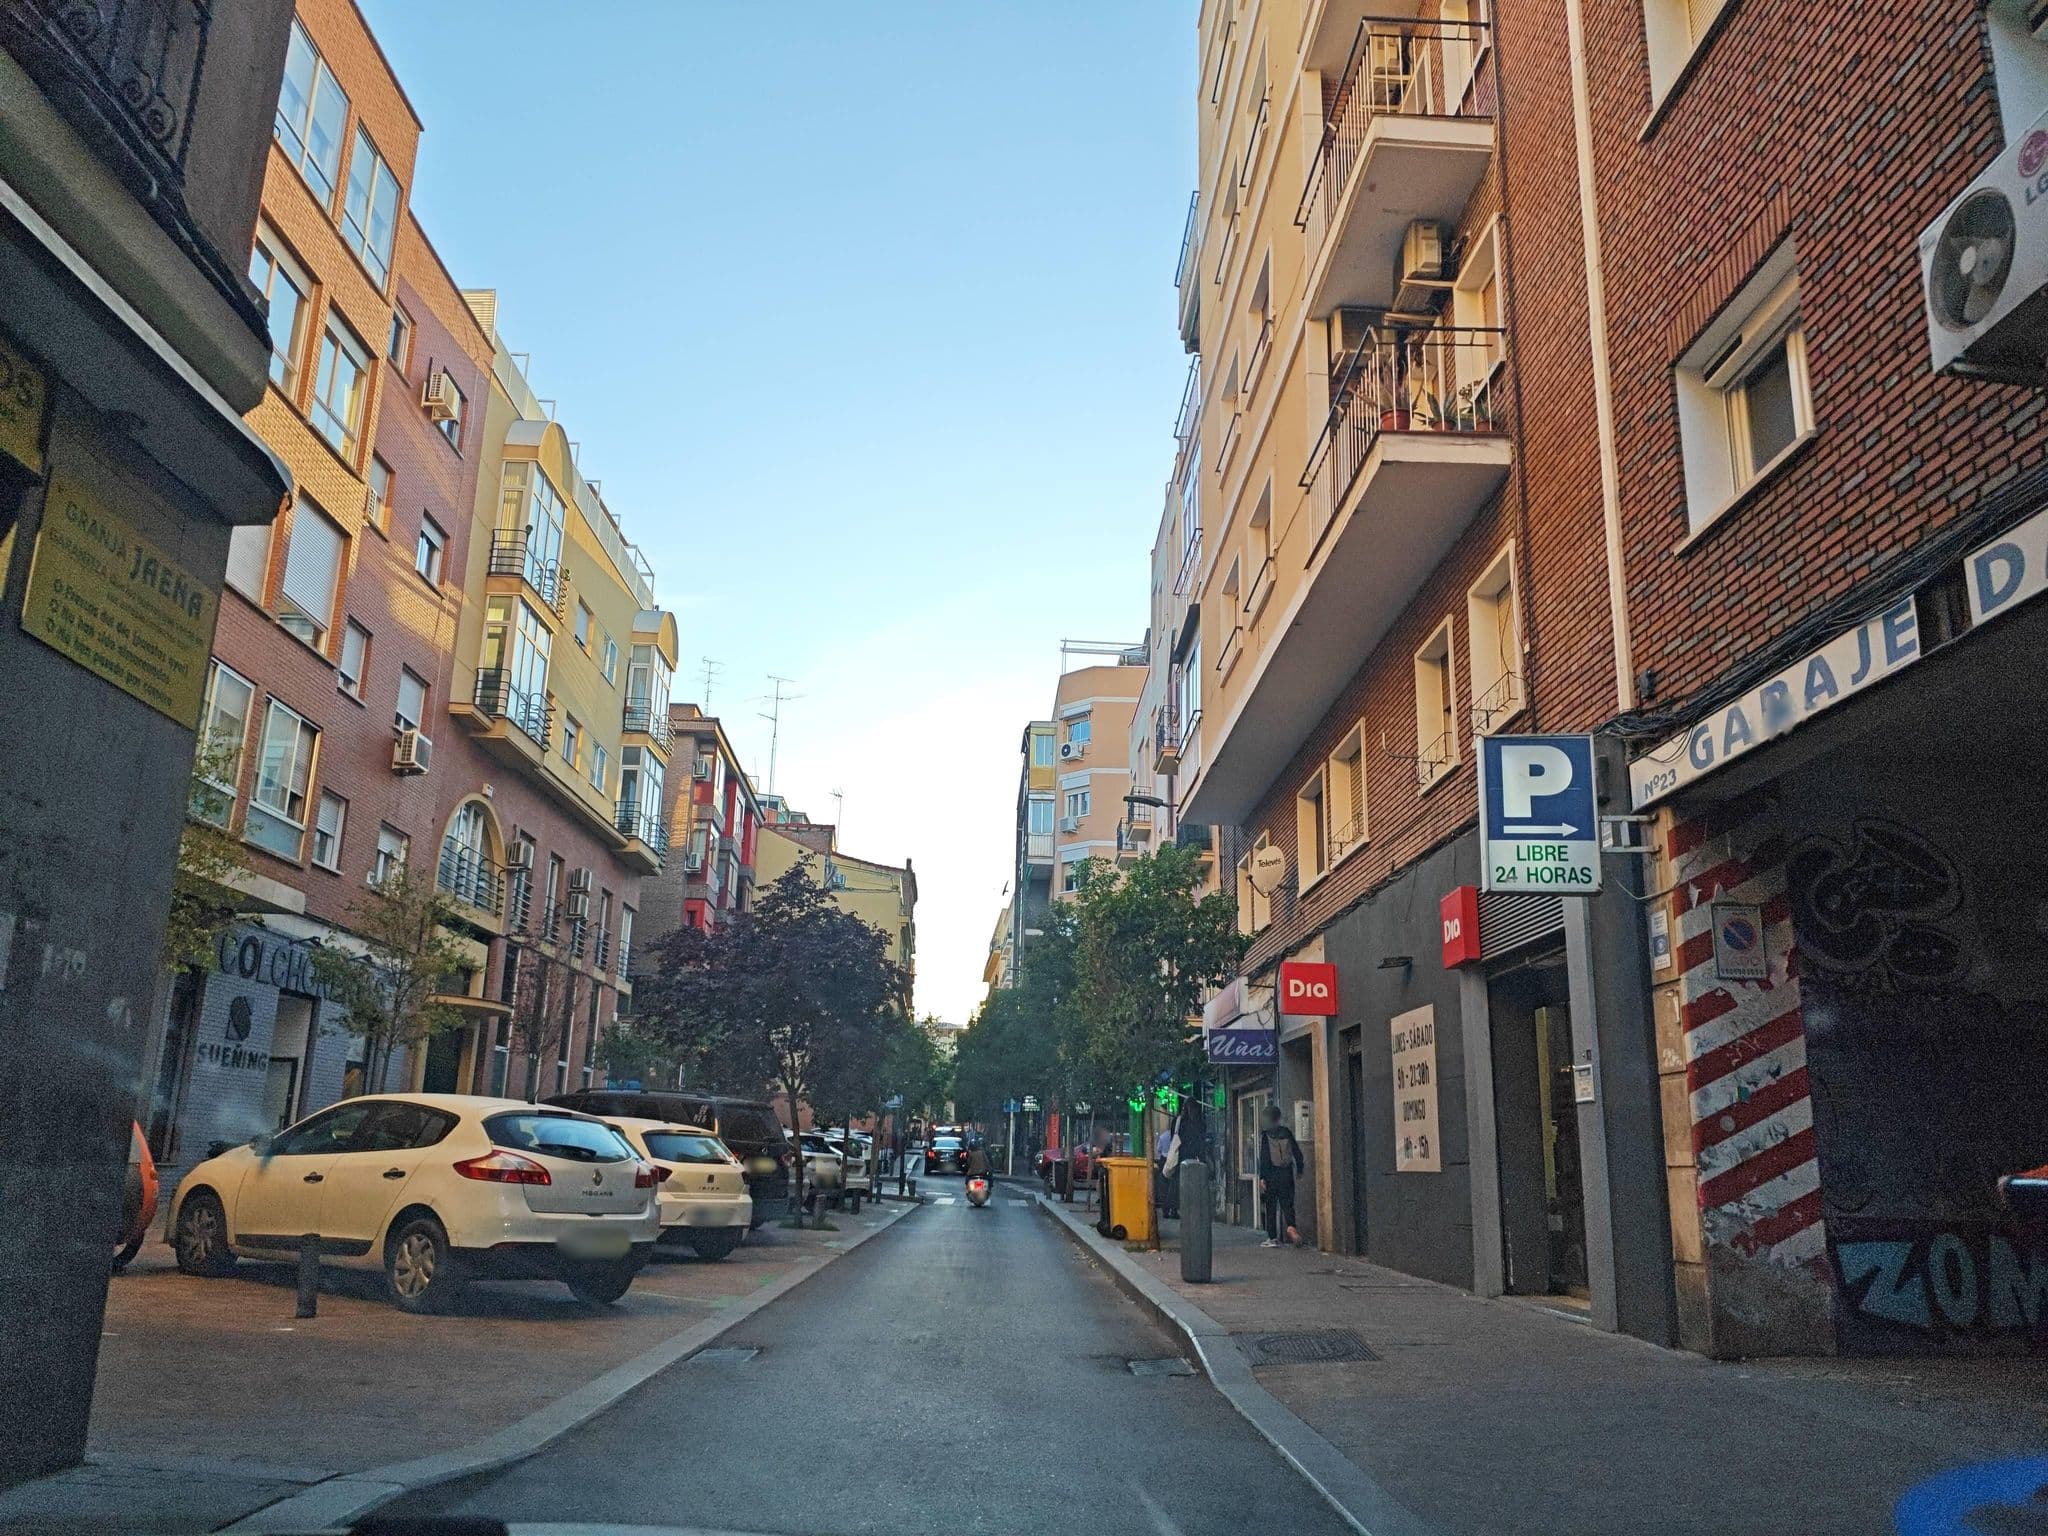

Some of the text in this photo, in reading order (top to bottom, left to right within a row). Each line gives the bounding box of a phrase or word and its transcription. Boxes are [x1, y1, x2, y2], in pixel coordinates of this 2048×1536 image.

[1974, 542, 2048, 615] D
[1501, 745, 1573, 817] P
[1516, 845, 1568, 861] LIBRE
[1495, 867, 1592, 884] 24 HORAS
[1409, 1023, 1433, 1049] SÁBADO
